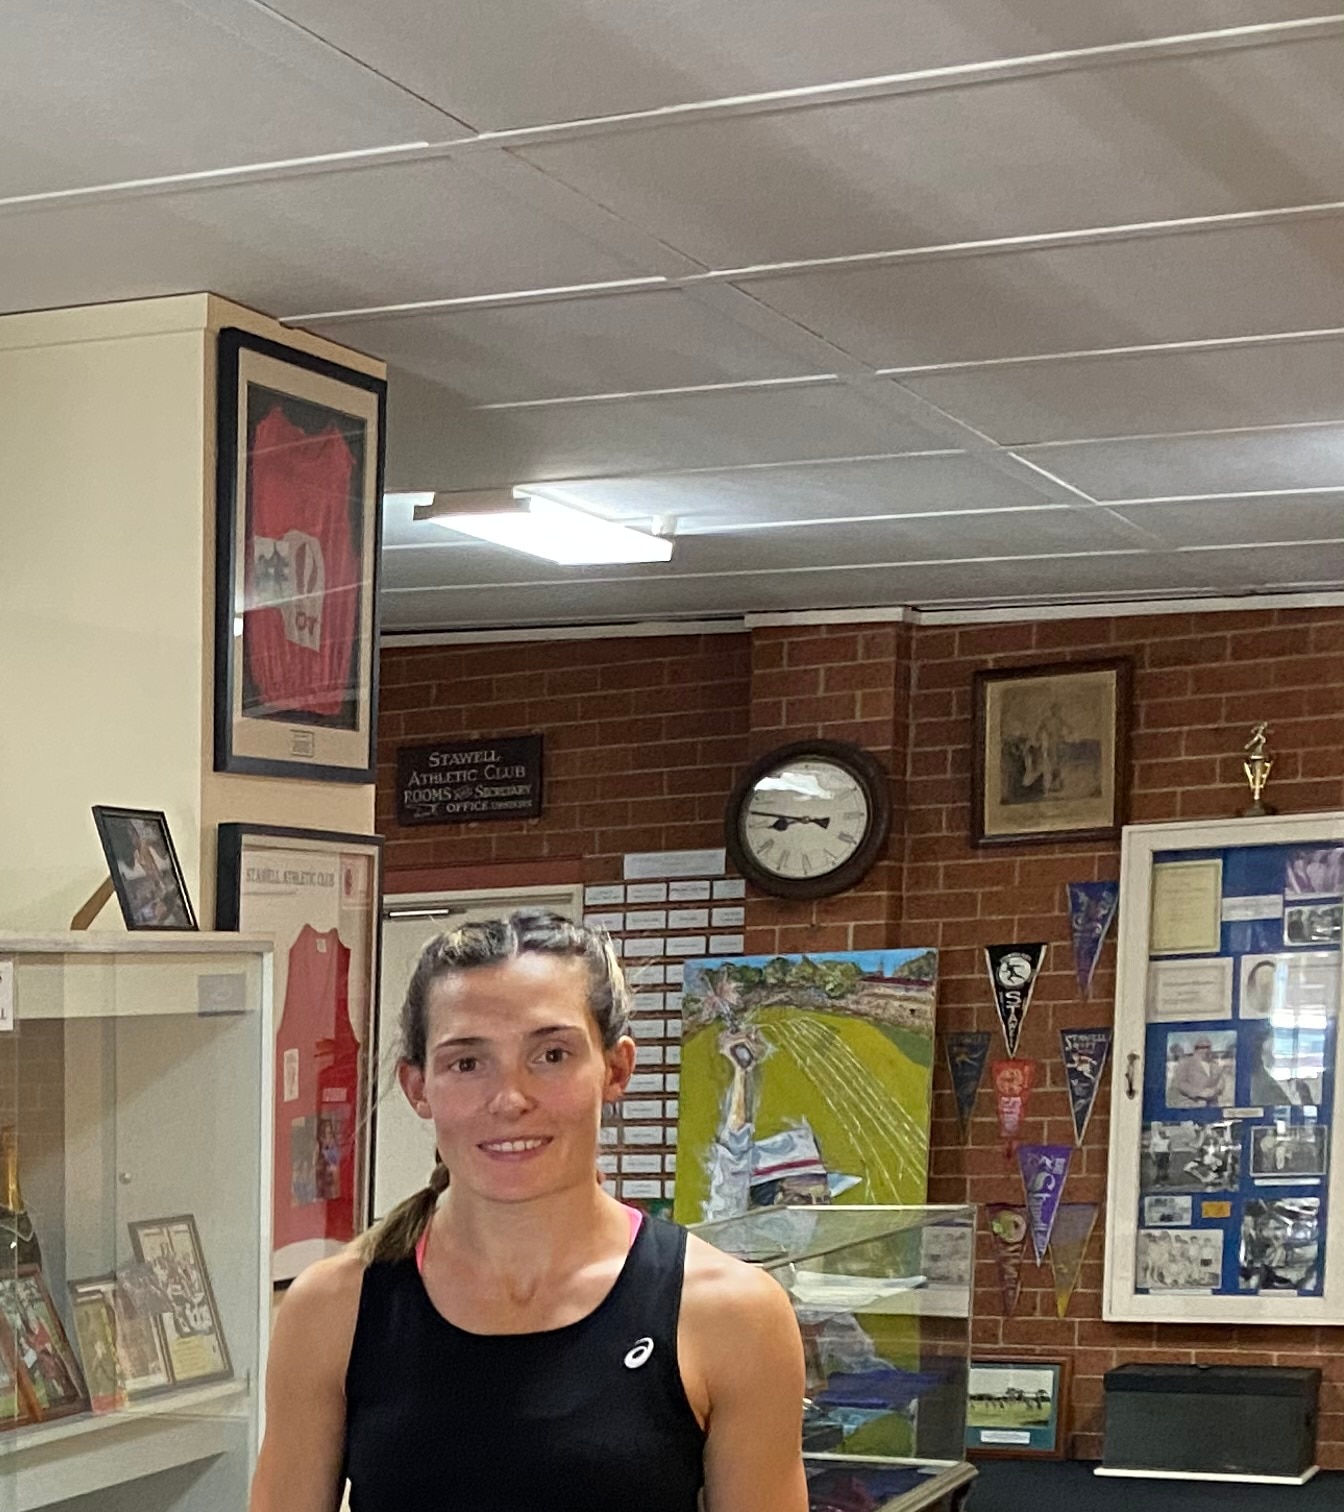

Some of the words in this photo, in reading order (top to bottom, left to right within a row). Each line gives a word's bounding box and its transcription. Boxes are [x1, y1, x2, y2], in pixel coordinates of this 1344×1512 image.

[428, 750, 502, 768] STAWELL
[407, 768, 478, 788] ATHLETIC
[483, 763, 526, 781] CLUB
[403, 787, 452, 804] ROOMS
[446, 800, 489, 813] OFFICE
[245, 868, 282, 887] STAWELL
